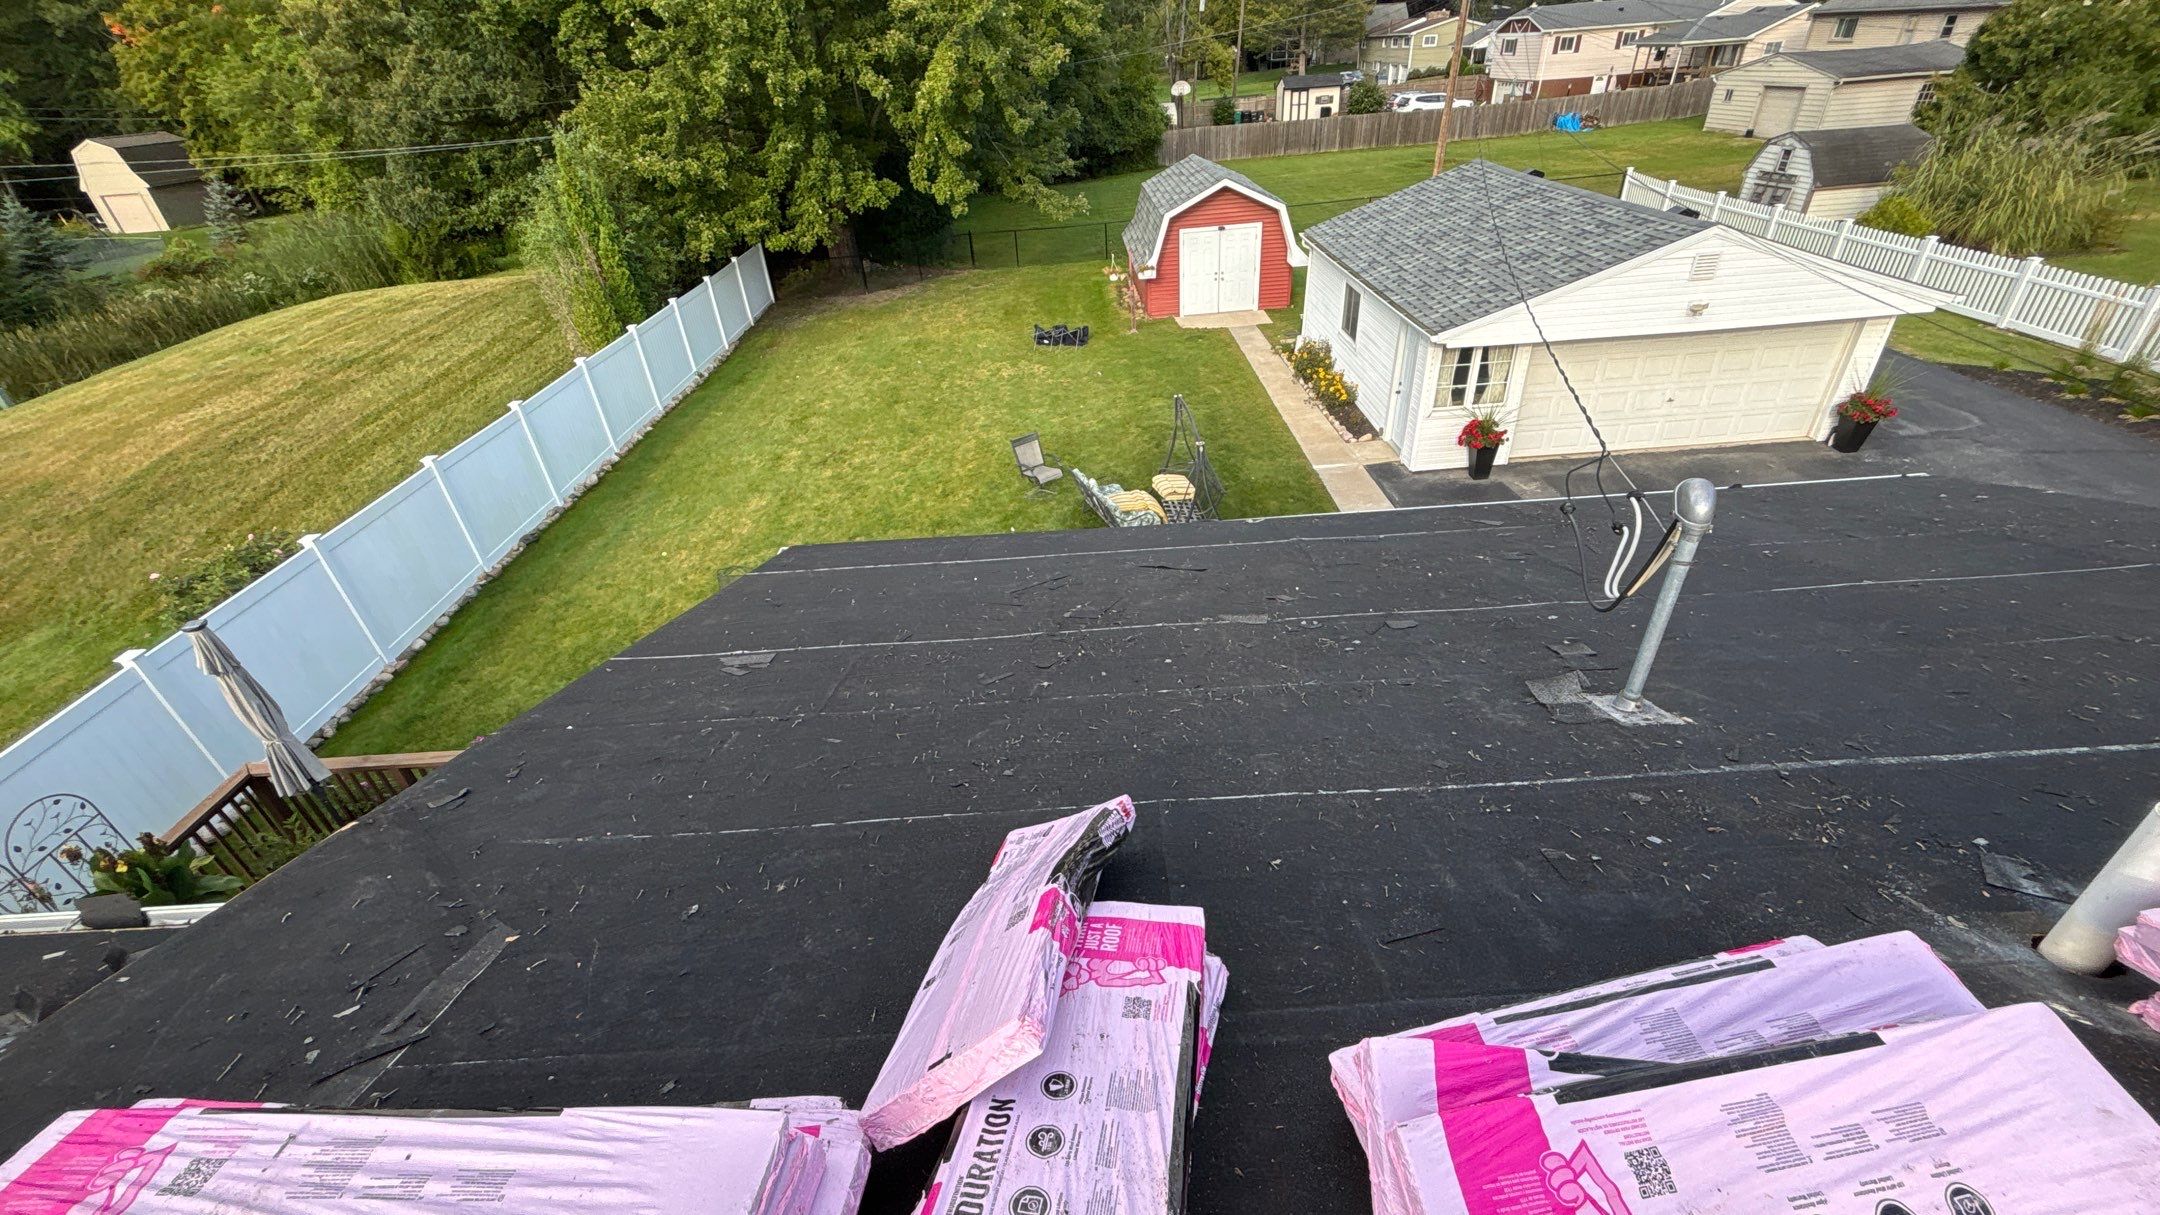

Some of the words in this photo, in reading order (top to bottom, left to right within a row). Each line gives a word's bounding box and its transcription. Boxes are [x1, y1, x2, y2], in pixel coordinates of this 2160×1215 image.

[1084, 930, 1102, 950] JUST
[1100, 922, 1123, 952] ROOF
[953, 1098, 1016, 1215] DURATION
